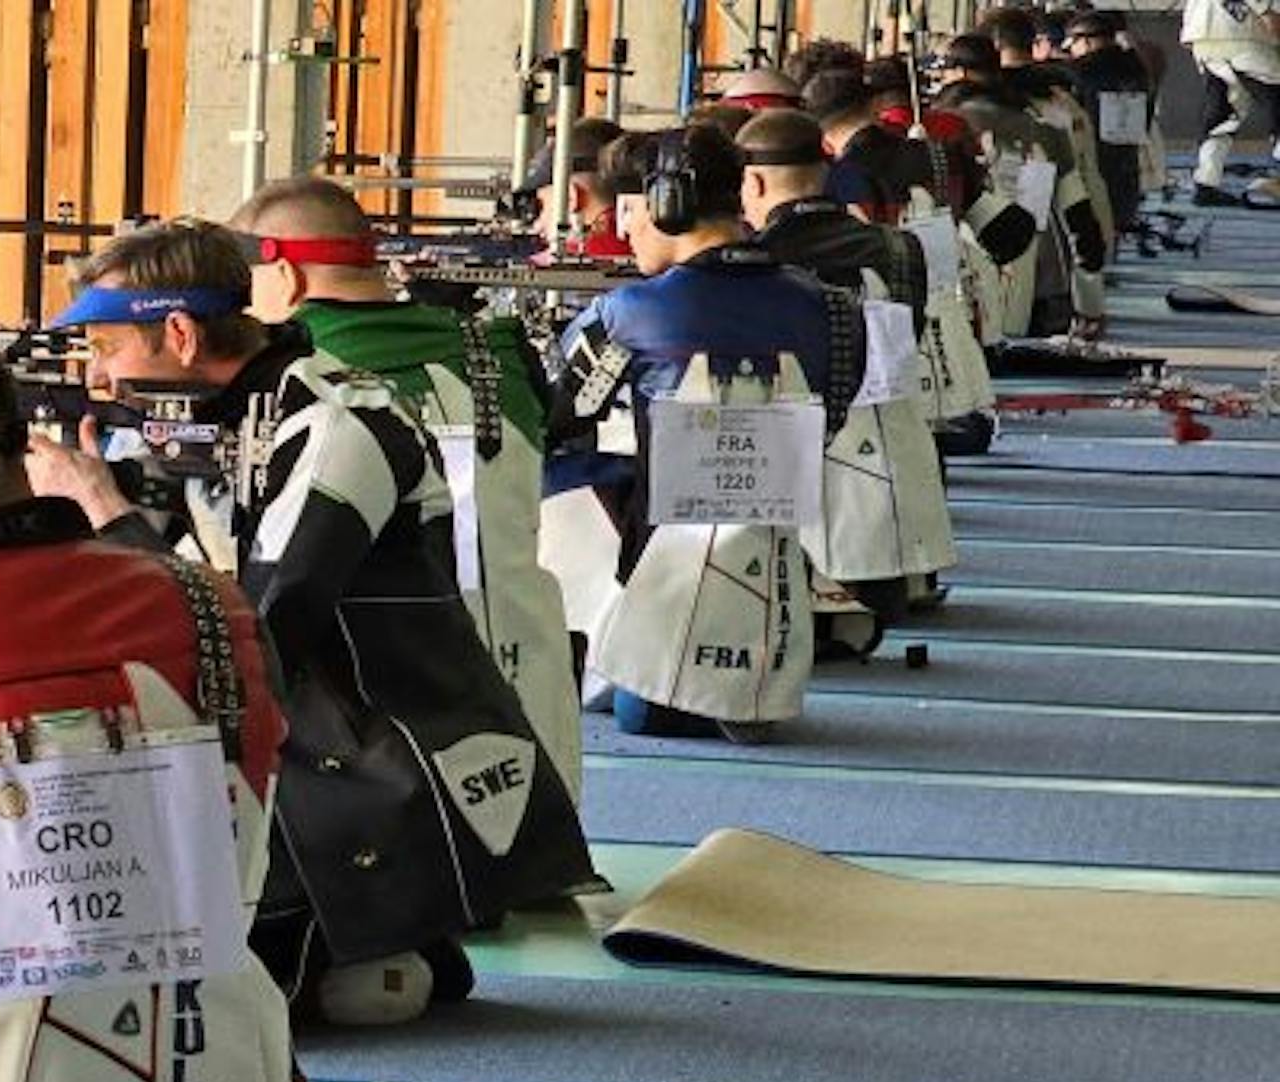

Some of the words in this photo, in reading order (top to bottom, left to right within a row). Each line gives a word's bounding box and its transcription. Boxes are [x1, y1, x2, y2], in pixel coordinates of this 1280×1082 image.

[716, 435, 757, 451] FRA
[715, 473, 757, 490] 1220
[694, 645, 753, 671] FRA
[461, 757, 525, 806] SWE
[36, 819, 115, 855] CRO
[6, 858, 123, 890] MIKULJAN
[47, 891, 125, 925] 1102
